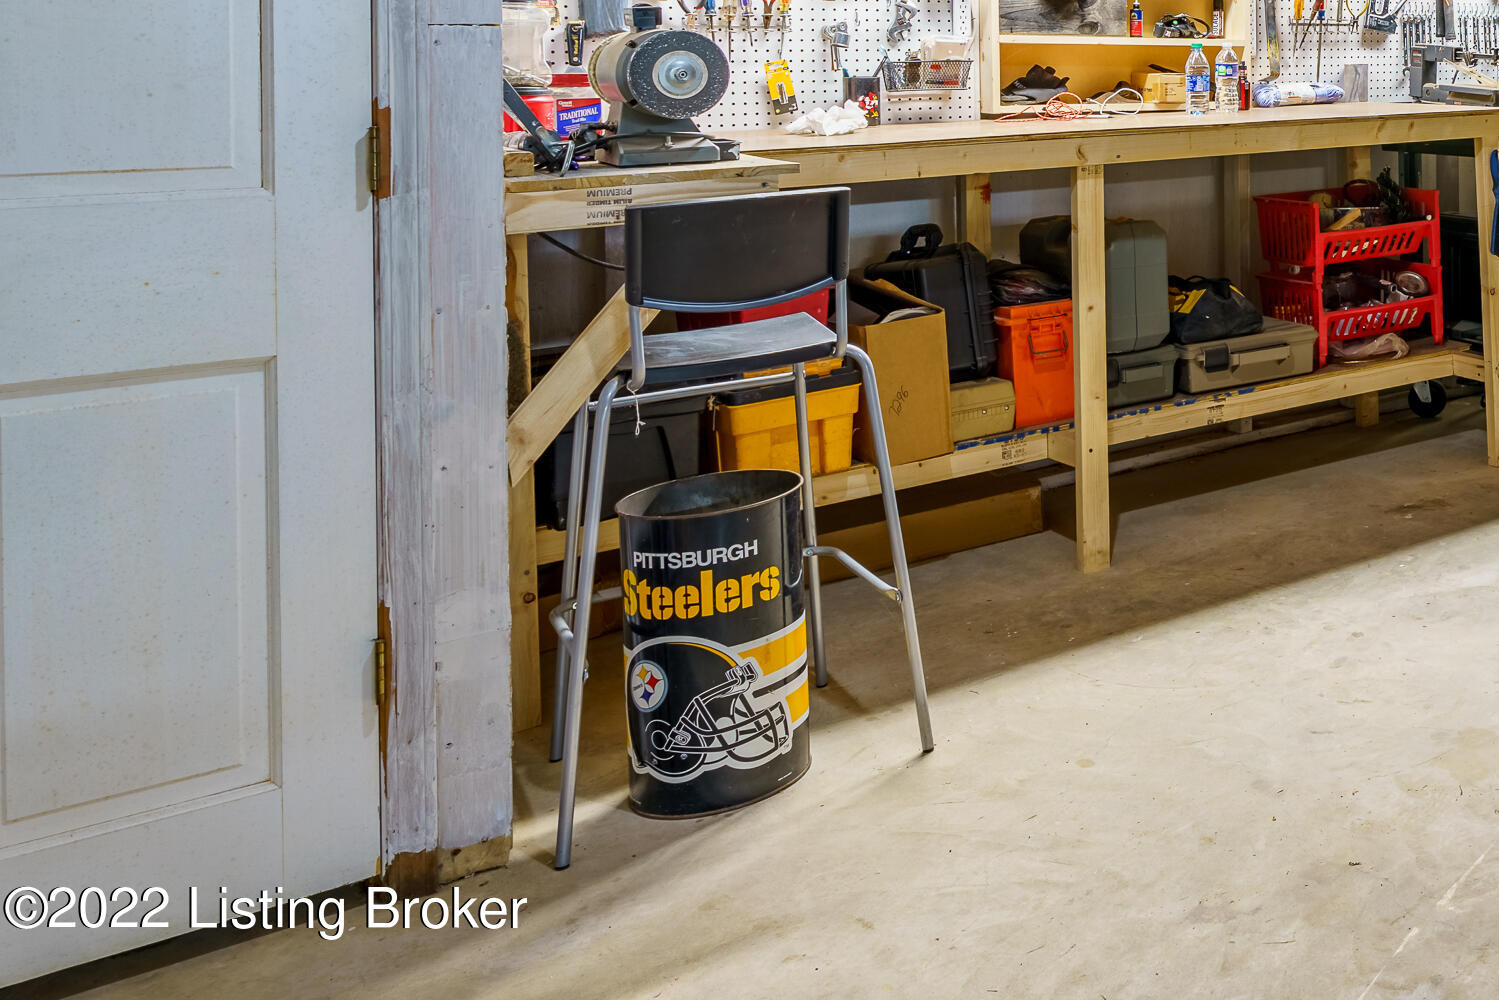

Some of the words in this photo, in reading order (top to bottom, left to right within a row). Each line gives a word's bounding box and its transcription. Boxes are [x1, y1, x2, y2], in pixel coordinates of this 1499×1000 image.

[558, 106, 599, 121] TRADITIONAL
[586, 188, 633, 198] PREMIUM
[586, 209, 626, 219] REMIUM
[633, 539, 759, 570] PITTSBURGH
[623, 565, 781, 621] Steelers
